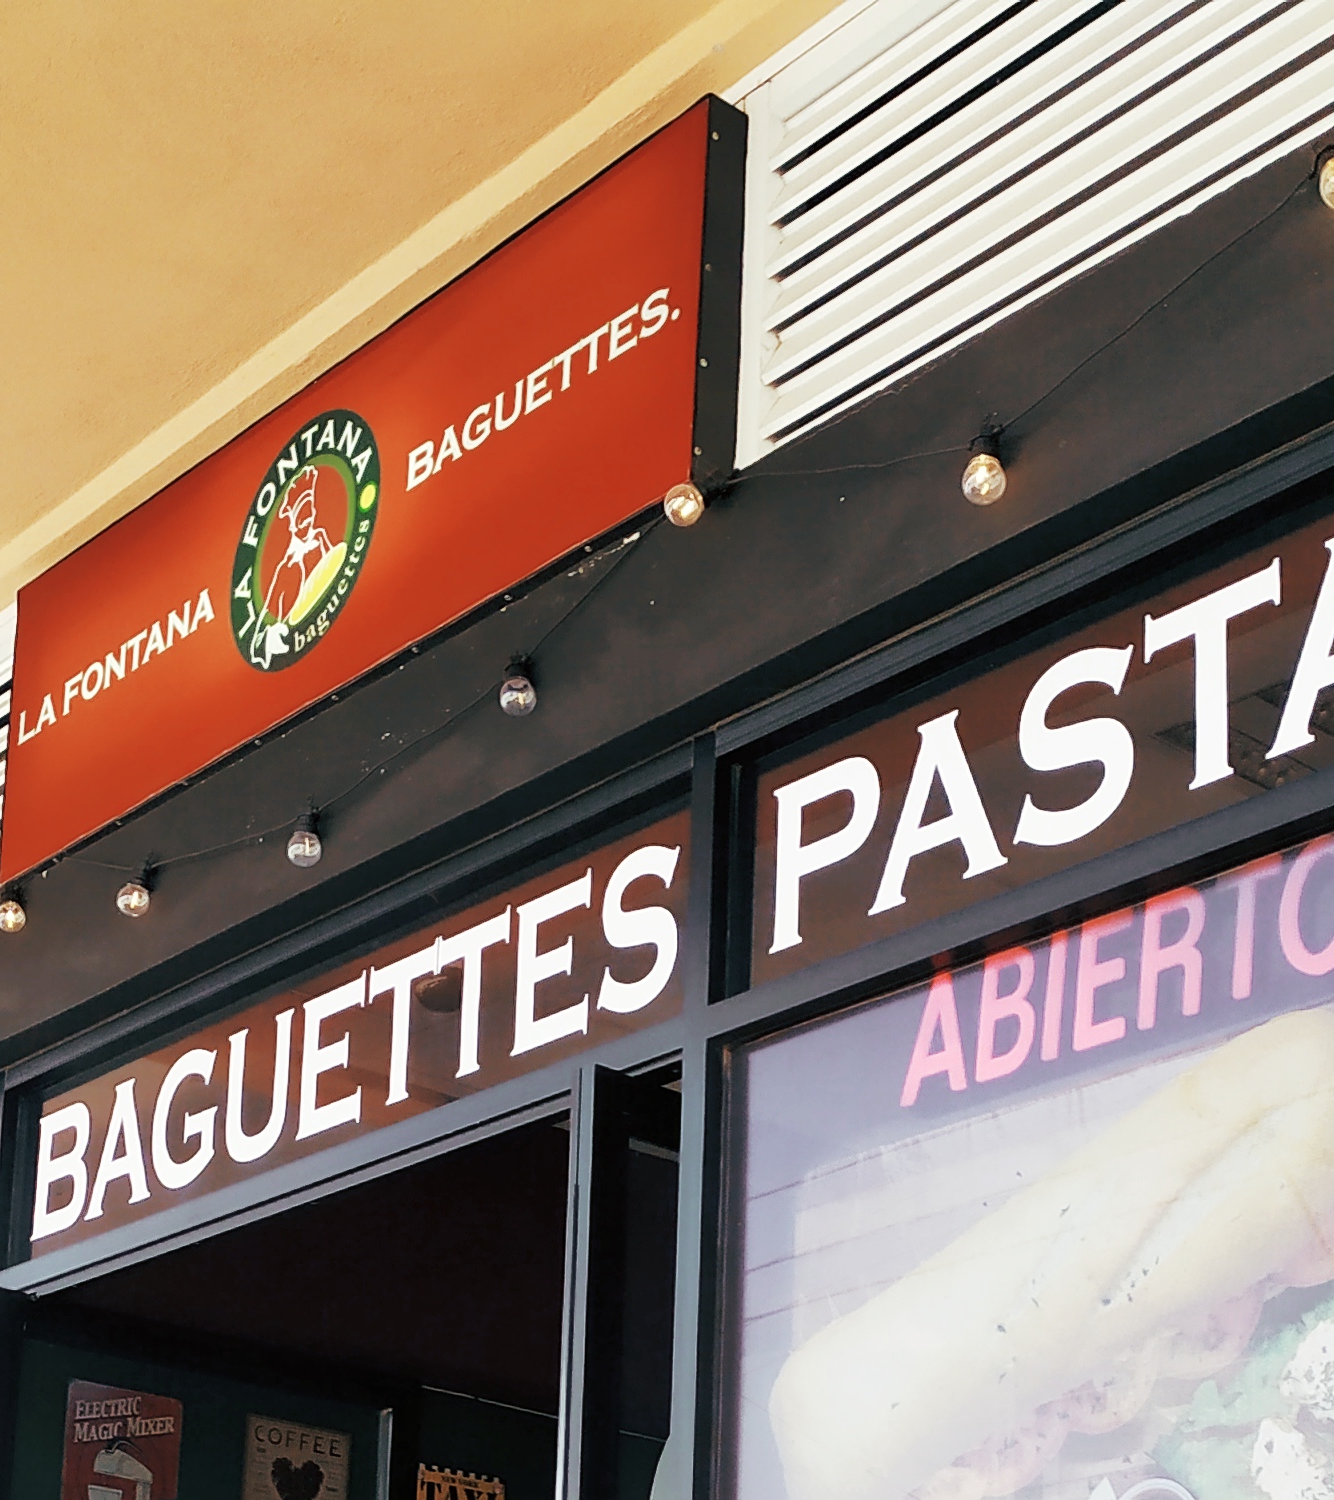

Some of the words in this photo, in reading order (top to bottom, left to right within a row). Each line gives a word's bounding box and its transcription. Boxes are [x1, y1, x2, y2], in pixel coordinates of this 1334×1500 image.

[17, 692, 63, 746] LA
[61, 588, 216, 717] FONTANA
[405, 287, 681, 492] BAGUETTES.
[243, 418, 375, 548] FONTANA
[233, 582, 255, 636] LA
[293, 517, 371, 654] baguettes
[29, 844, 687, 1244] BAGUETTES
[73, 1421, 123, 1443] MAGIC
[126, 1415, 175, 1438] MIXER
[74, 1396, 142, 1420] ELECTRIC
[253, 1424, 342, 1459] COFFEE
